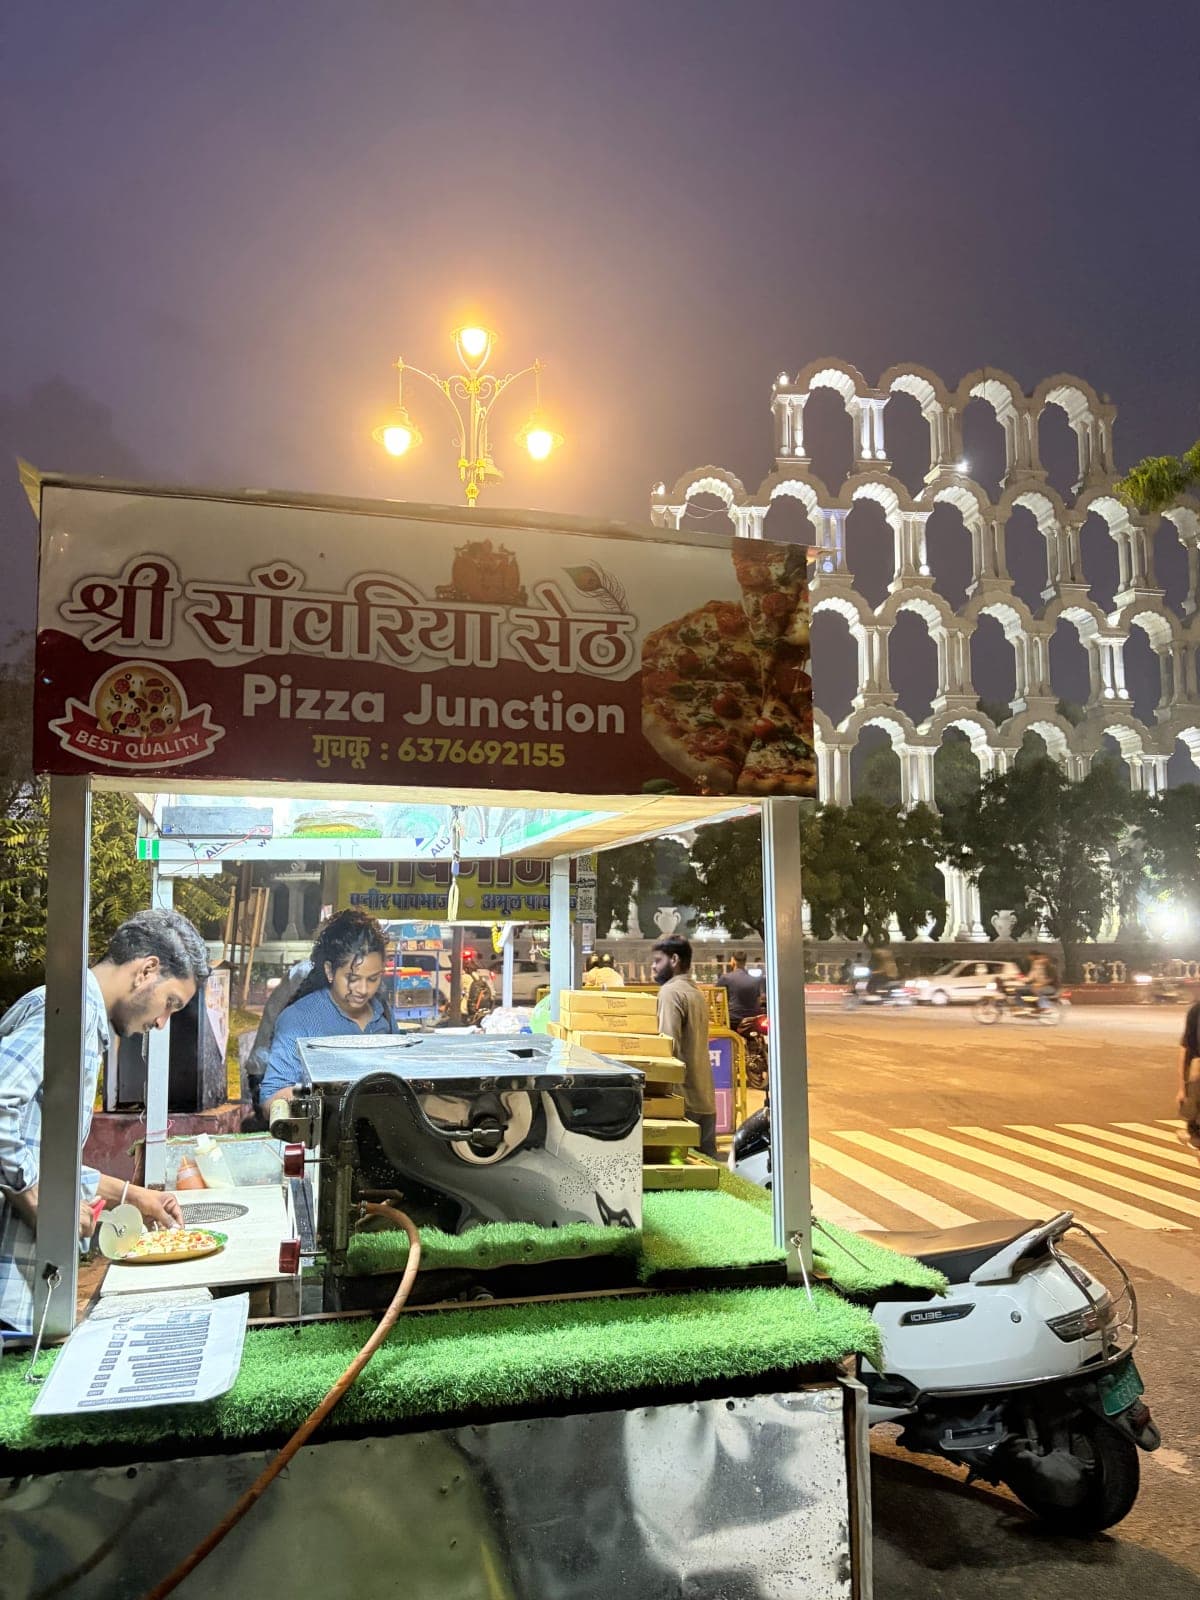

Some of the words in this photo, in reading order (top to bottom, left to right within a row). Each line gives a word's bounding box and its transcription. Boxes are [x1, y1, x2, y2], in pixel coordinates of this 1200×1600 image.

[69, 562, 175, 645] श्री
[513, 589, 631, 668] सेठ
[242, 673, 385, 724] Pizza
[402, 684, 625, 734] Junction
[75, 730, 122, 754] BEST
[125, 732, 200, 759] QUALITY
[398, 737, 566, 768] 6376692155
